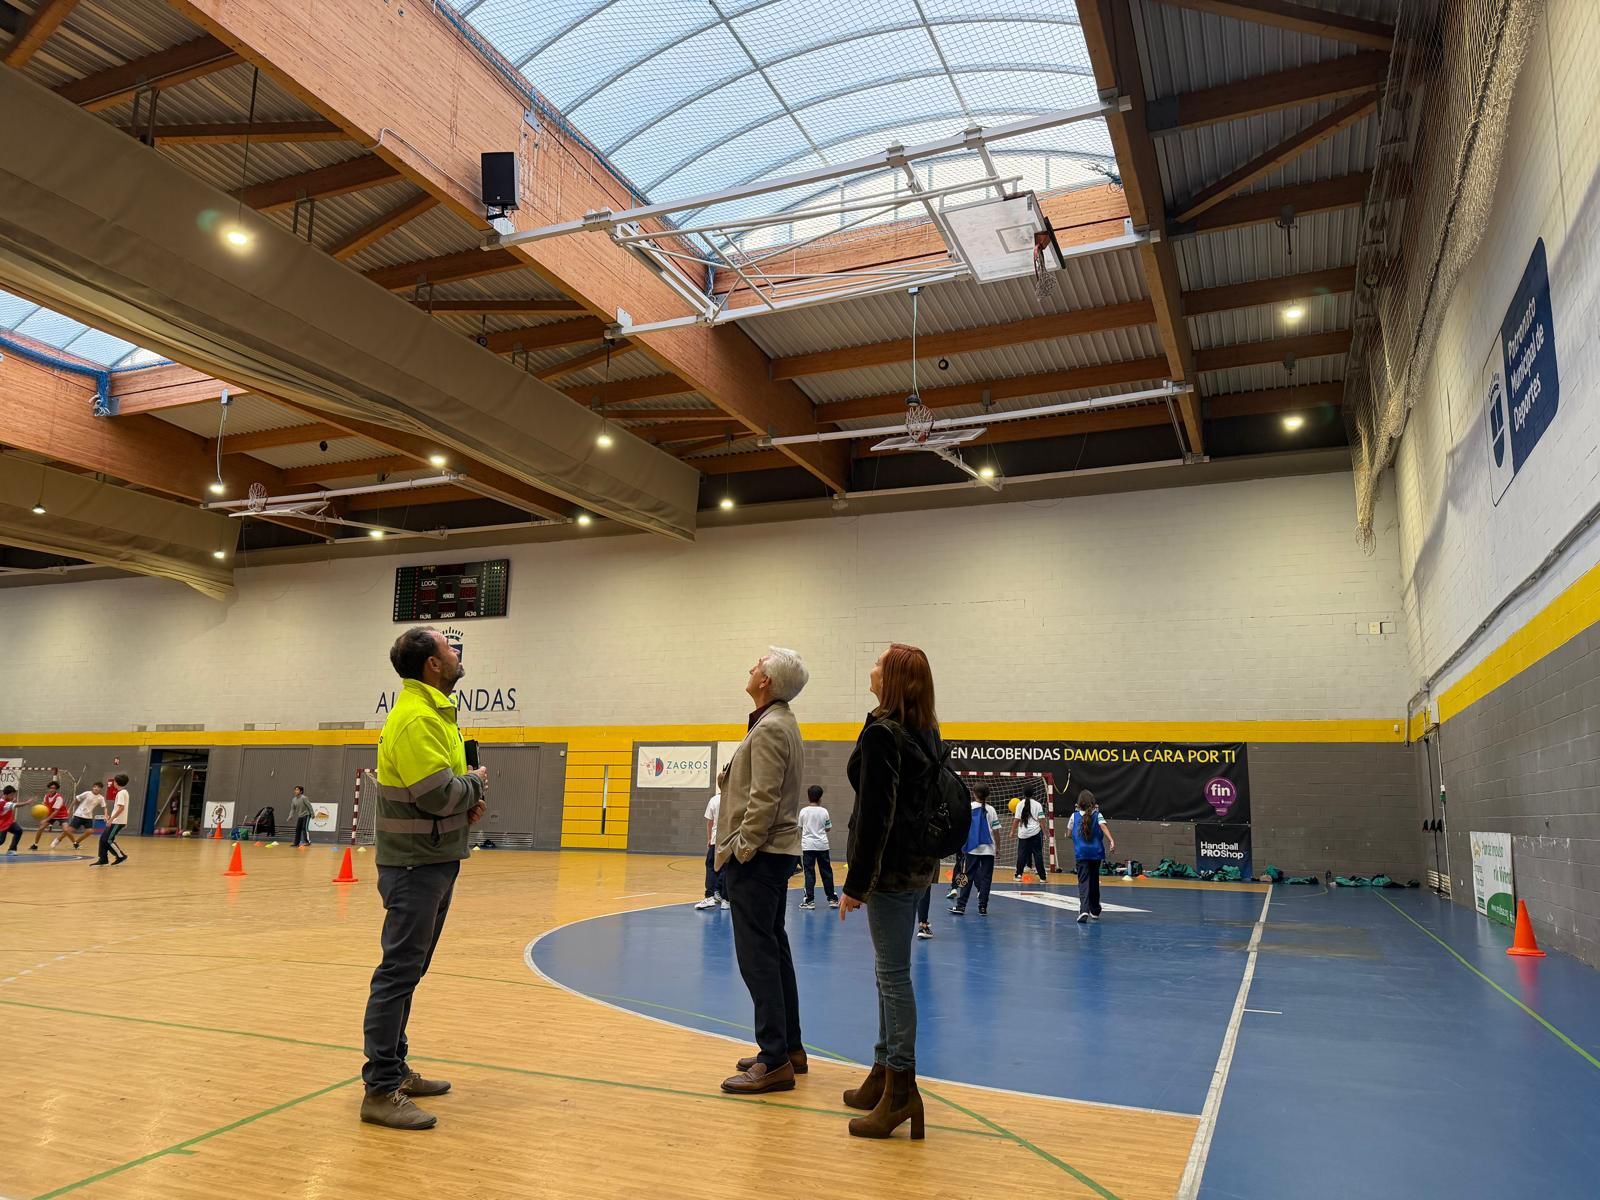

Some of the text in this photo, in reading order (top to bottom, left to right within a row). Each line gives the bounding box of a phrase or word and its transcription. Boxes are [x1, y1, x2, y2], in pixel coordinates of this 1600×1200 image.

[1508, 296, 1536, 366] Patronato
[1510, 322, 1545, 399] Municipal de
[1513, 372, 1542, 433] Deportes
[421, 580, 437, 588] LOCAL
[950, 747, 1236, 763] EN ALCOBENDAS DAMOS LA CARA POR TI
[666, 760, 709, 770] ZAGROS
[1210, 783, 1231, 797] fin
[1200, 841, 1239, 851] Handball
[1200, 849, 1244, 860] PROShop
